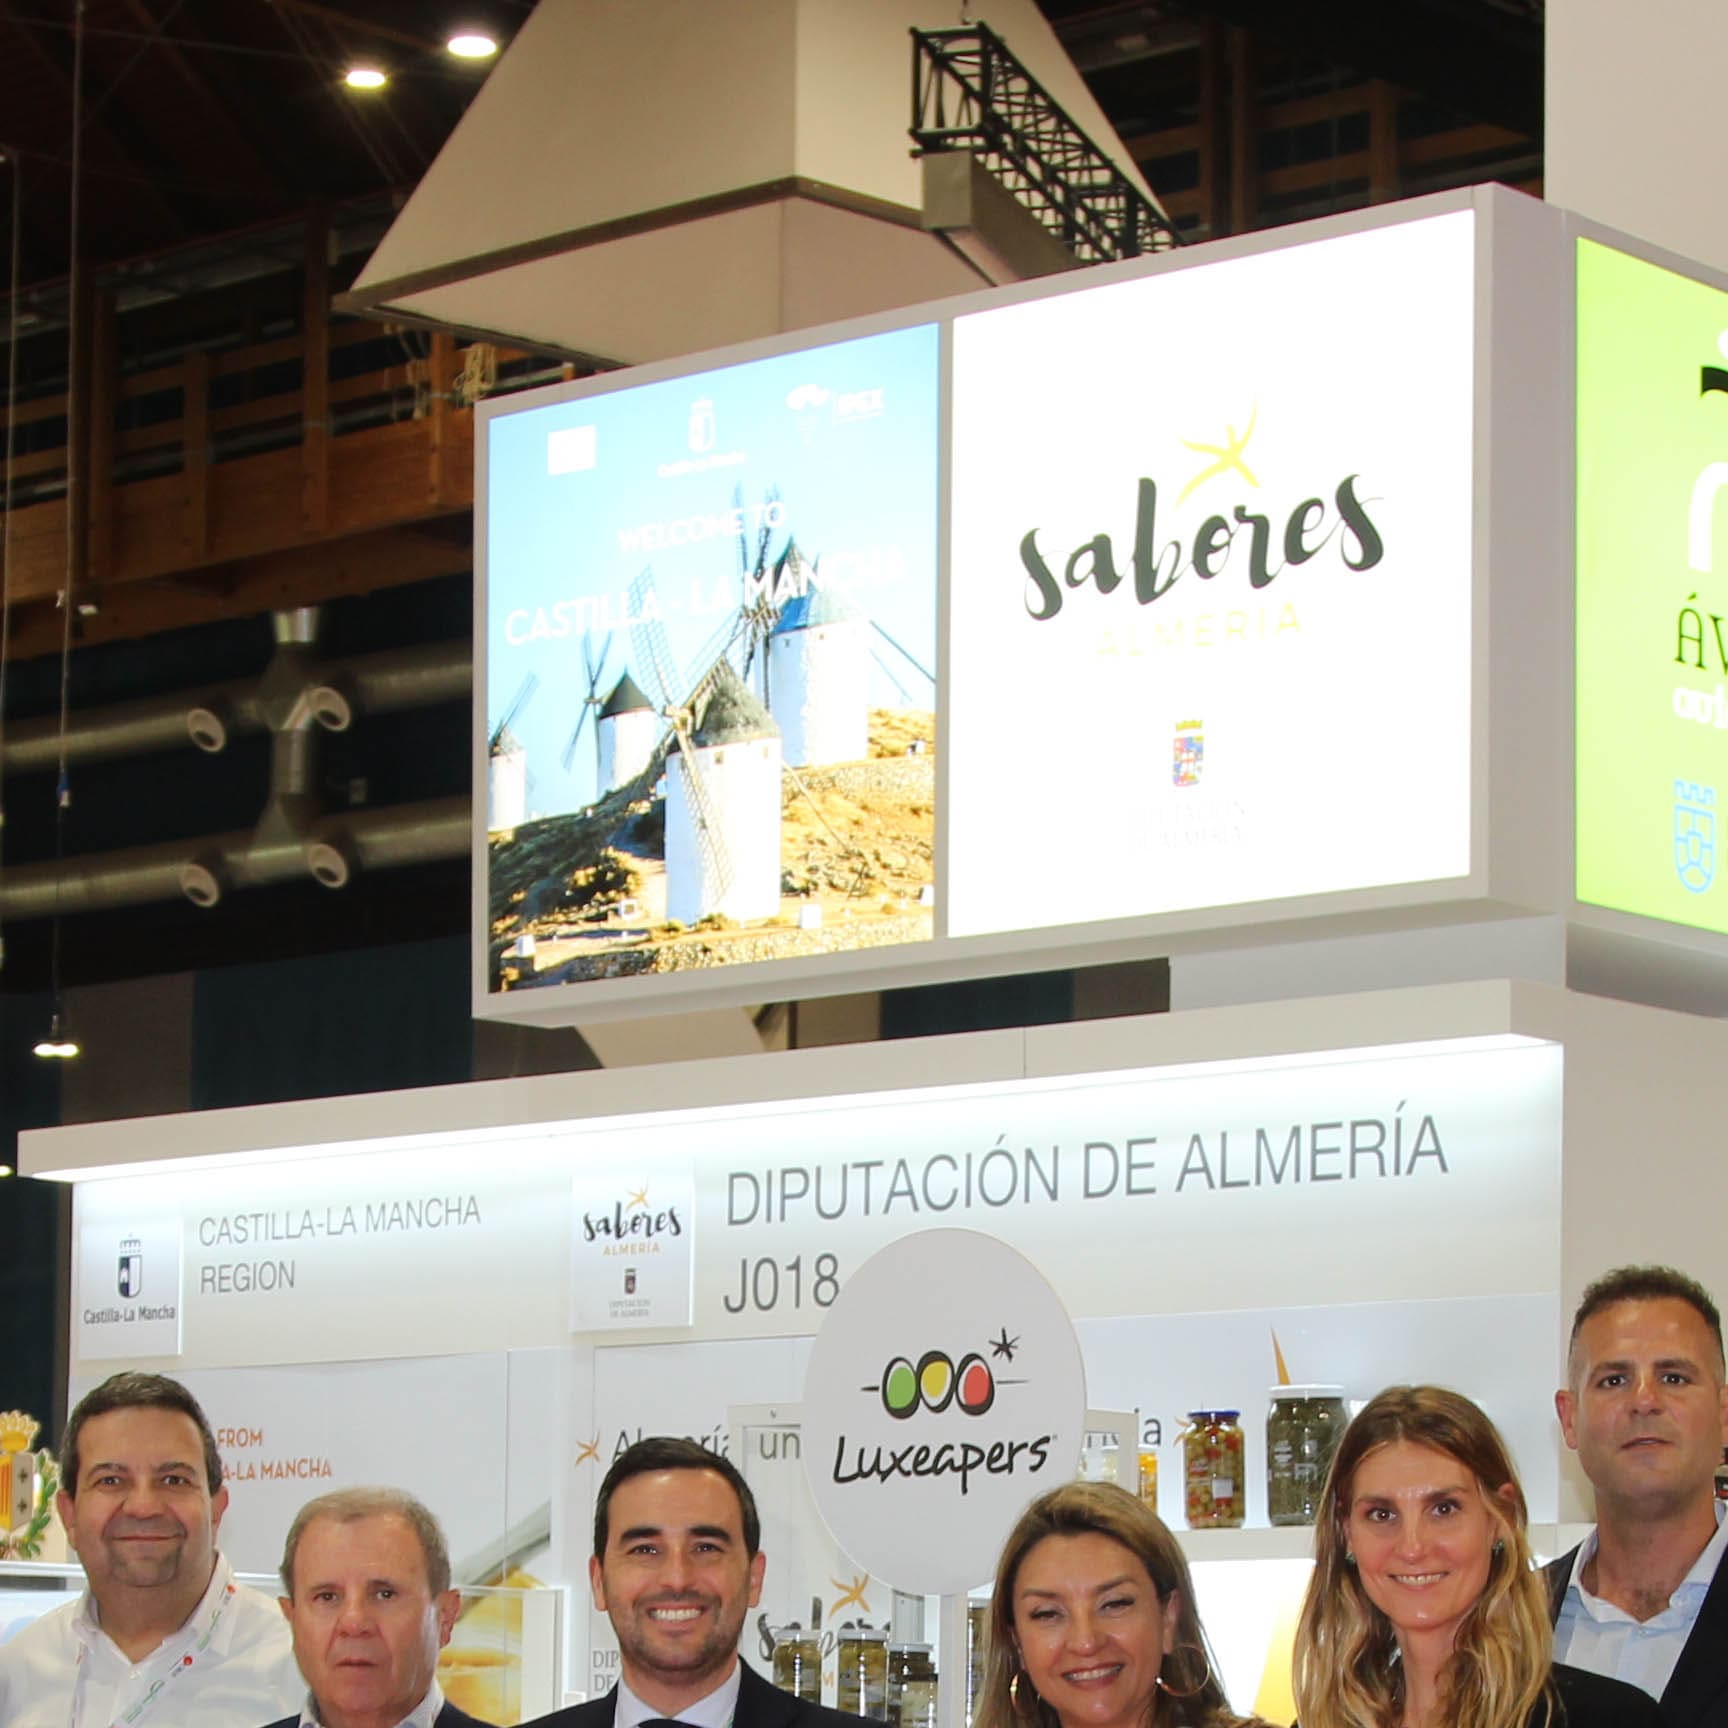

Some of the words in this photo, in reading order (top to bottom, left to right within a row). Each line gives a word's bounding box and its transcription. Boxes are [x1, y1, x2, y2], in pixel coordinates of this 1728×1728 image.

[618, 507, 743, 553] WELCOME
[752, 502, 786, 529] TO
[505, 588, 661, 646] CASTILLA
[692, 574, 735, 611] LA
[744, 545, 908, 607] MANCHA
[727, 1133, 1061, 1227] DIPUTACIÓN
[1082, 1137, 1158, 1199] DE
[1176, 1101, 1450, 1193] ALMERÍA
[198, 1202, 357, 1247] CASTILLA-LA
[364, 1194, 482, 1231] MANCHA
[200, 1260, 296, 1295] REGION
[723, 1254, 841, 1316] J018
[83, 1309, 135, 1325] Castilla-La
[138, 1305, 176, 1321] Mancha
[217, 1428, 264, 1449] FROM
[260, 1458, 333, 1479] MANCHA
[833, 1434, 1051, 1496] Luxeapers
